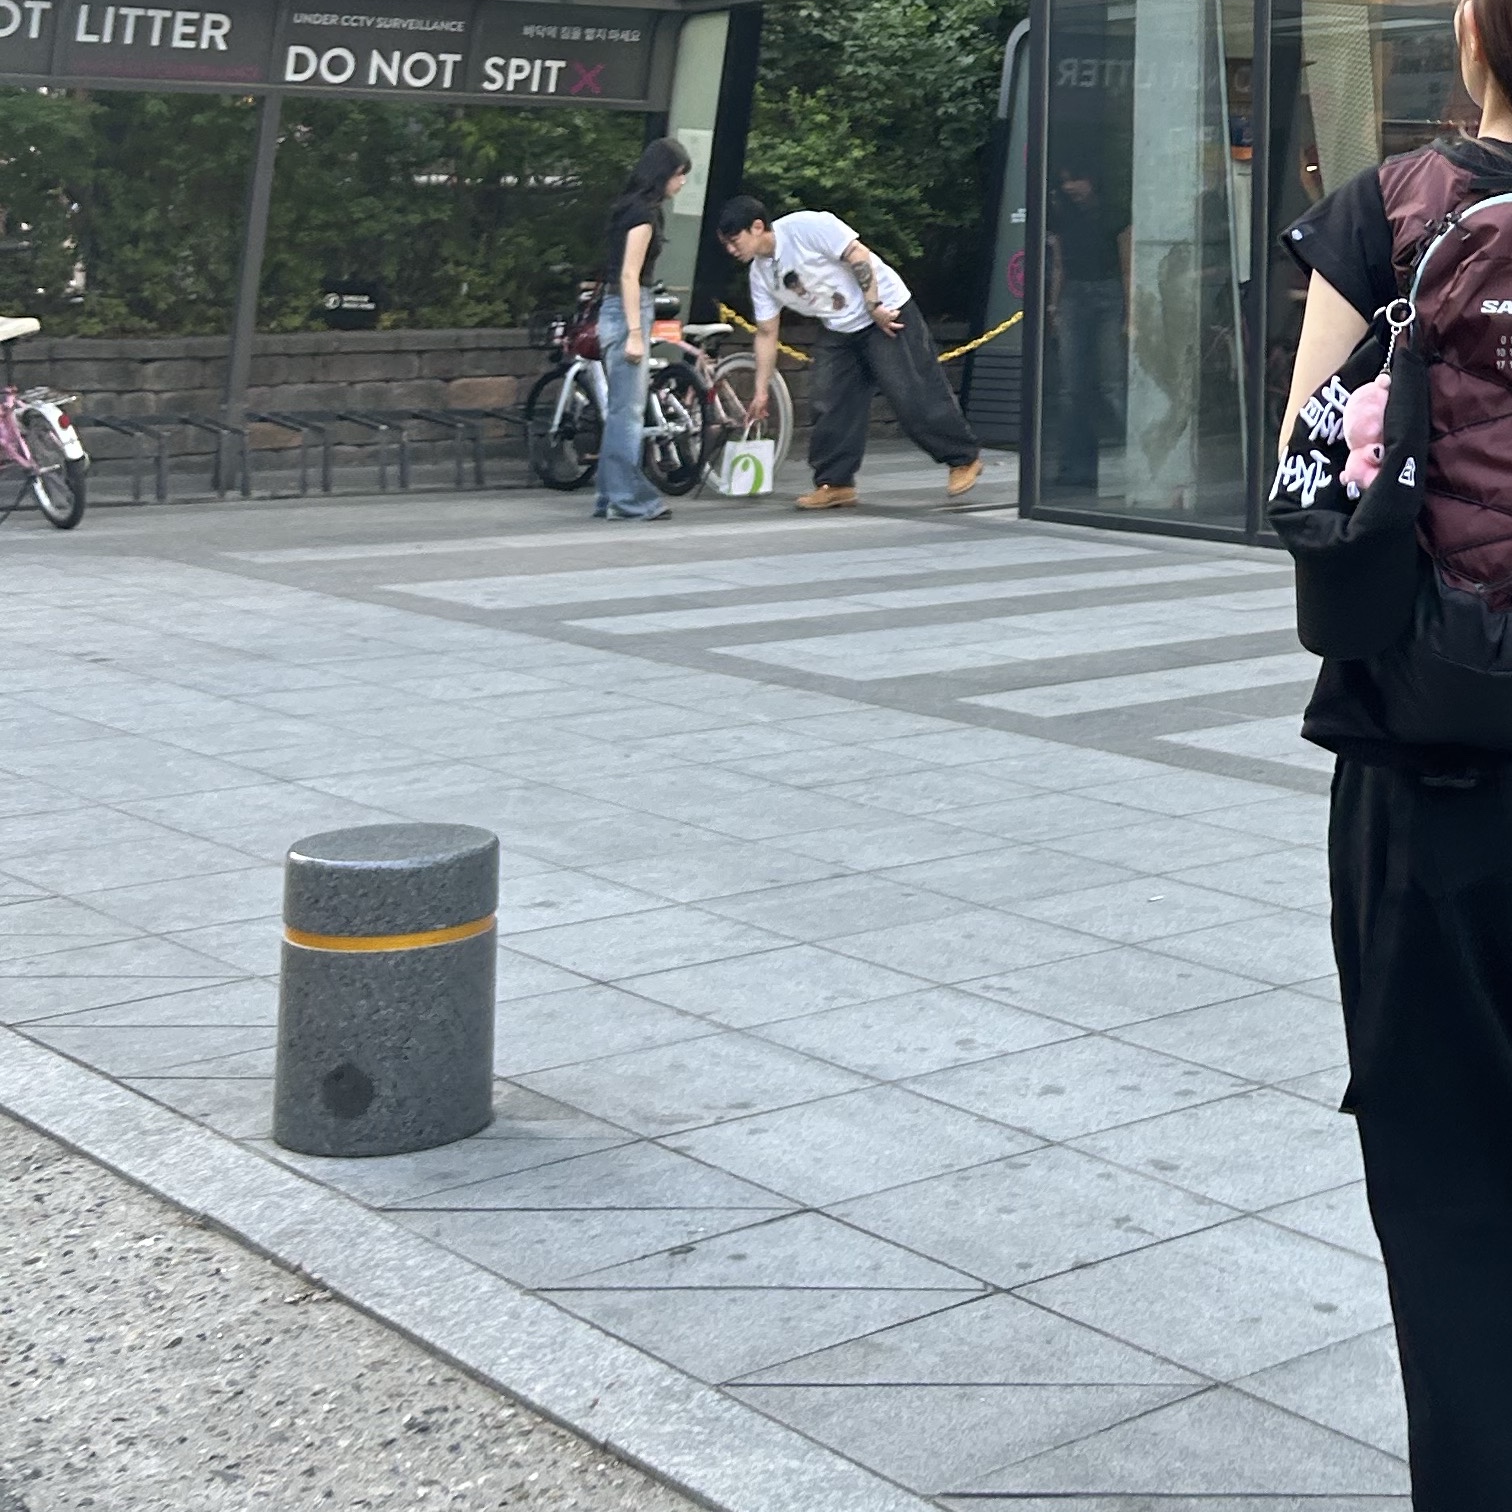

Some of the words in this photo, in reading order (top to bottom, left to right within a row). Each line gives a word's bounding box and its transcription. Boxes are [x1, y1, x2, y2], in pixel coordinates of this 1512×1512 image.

[75, 3, 232, 51] LITTER
[293, 12, 339, 26] UNDER
[341, 14, 375, 27] CCTV
[376, 16, 465, 33] SURVEILLANCE
[285, 44, 356, 84] DO
[368, 49, 462, 89] NOT
[482, 56, 567, 93] SPIT
